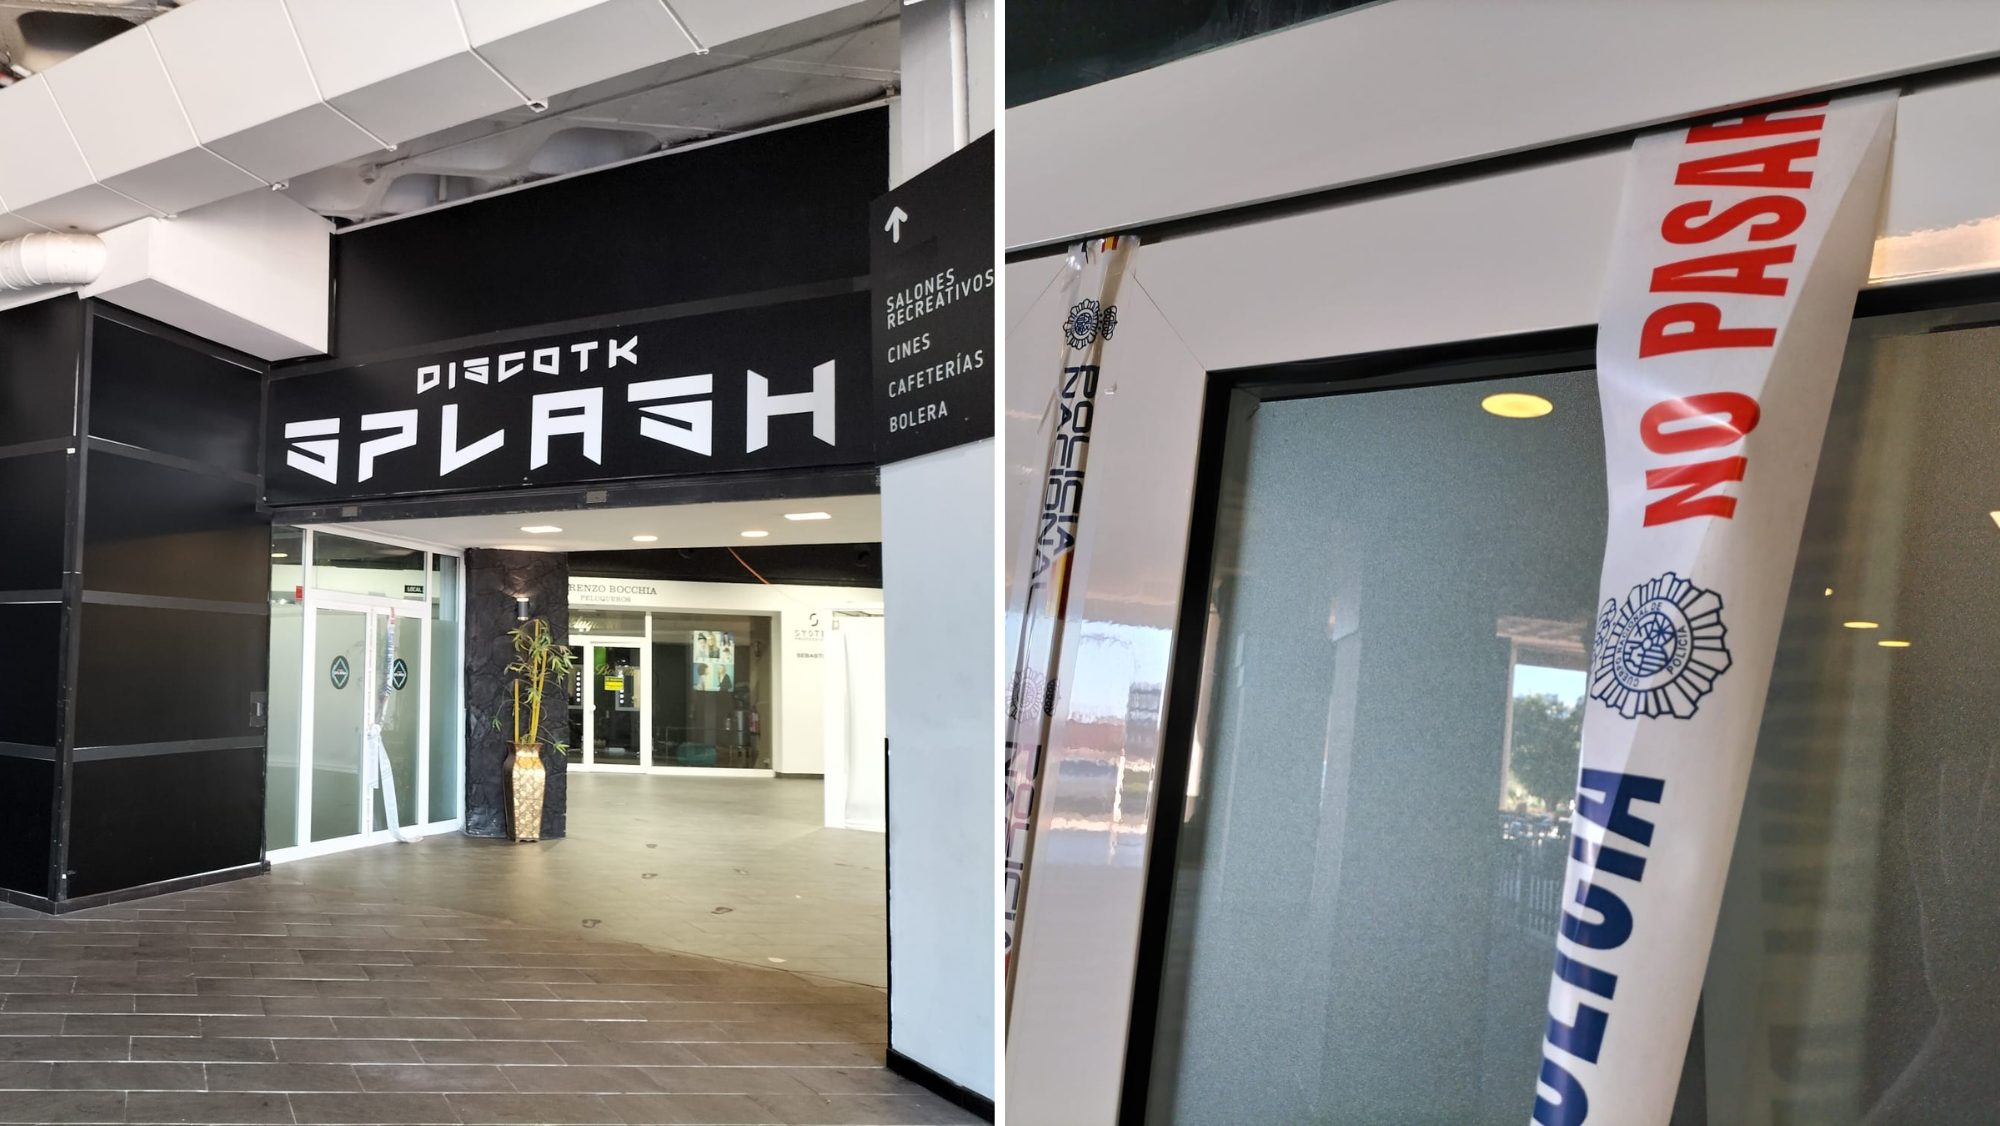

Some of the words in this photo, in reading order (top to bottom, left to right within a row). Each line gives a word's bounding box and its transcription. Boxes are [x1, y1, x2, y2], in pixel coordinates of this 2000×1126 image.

[886, 268, 955, 313] SALONES
[887, 268, 994, 330] RECREATIVOS
[417, 335, 638, 394] DISCOTK
[887, 333, 931, 364] CINES
[888, 350, 984, 398] CAFETERÍAS
[284, 359, 836, 484] SPLASH
[889, 400, 948, 433] BOLERA
[1052, 364, 1100, 555] POLICIA
[1640, 391, 1761, 527] NO
[568, 583, 606, 592] RENZO
[609, 585, 657, 595] BOCCHIA
[1651, 601, 1662, 611] DE
[1666, 625, 1688, 675] POLICIA
[1530, 767, 1665, 1126] OLICIA
